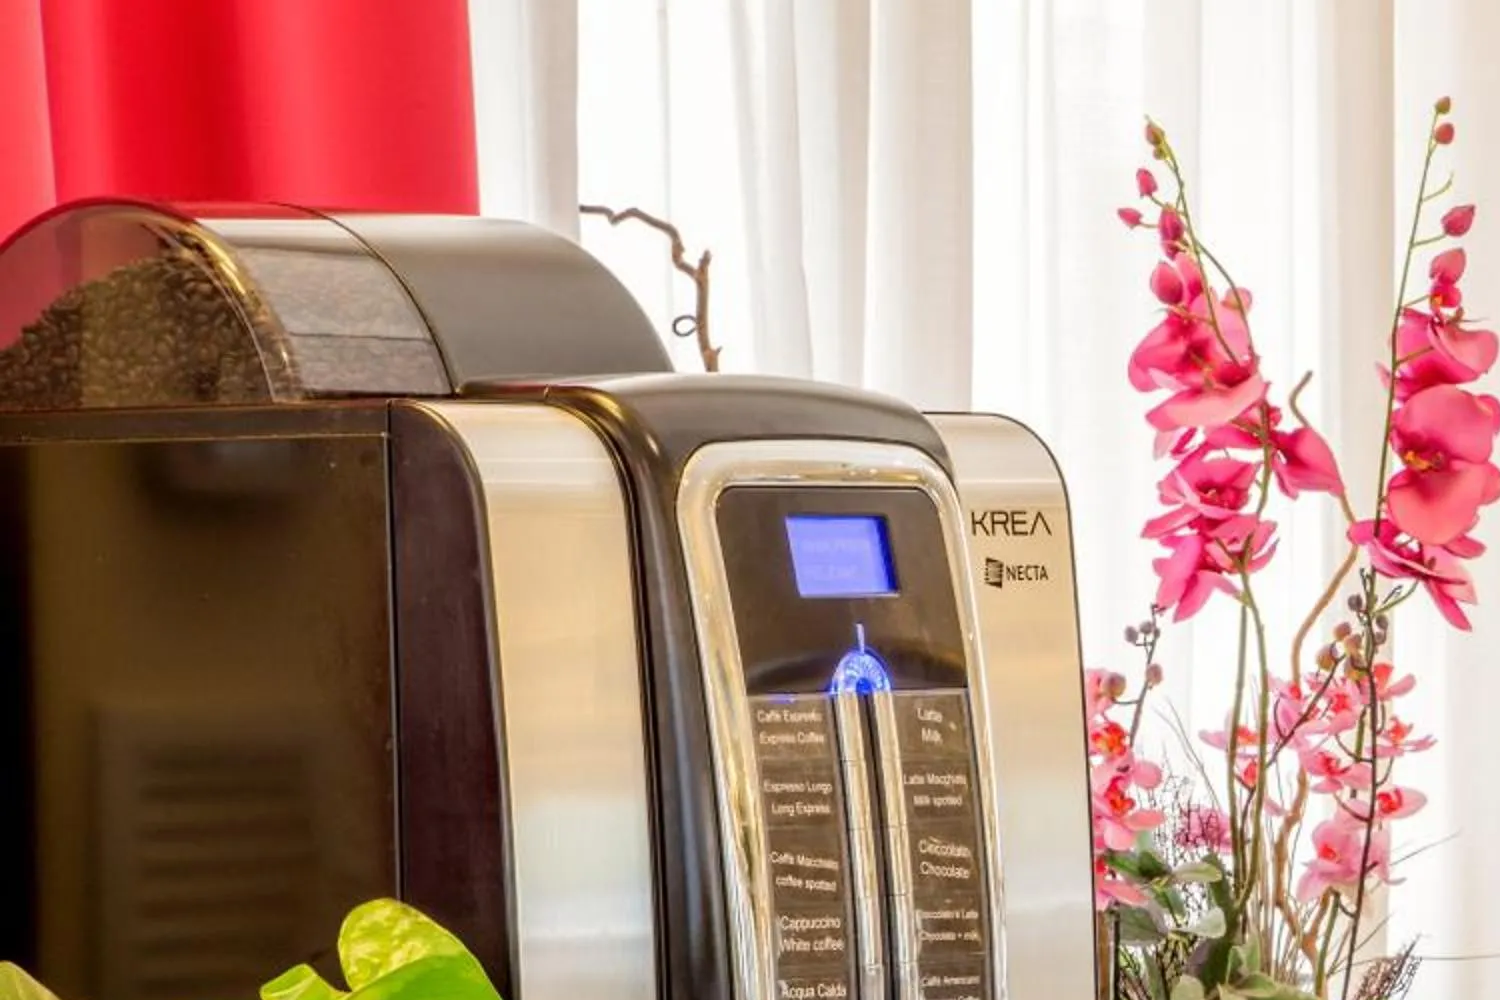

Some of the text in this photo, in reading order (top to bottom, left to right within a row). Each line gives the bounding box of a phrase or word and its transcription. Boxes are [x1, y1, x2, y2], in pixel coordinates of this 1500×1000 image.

[1006, 564, 1049, 581] NECTA
[771, 803, 795, 817] Long
[920, 861, 970, 879] Chocolate
[780, 915, 842, 932] Cappuccino
[781, 982, 847, 1000] Acqua Calda
